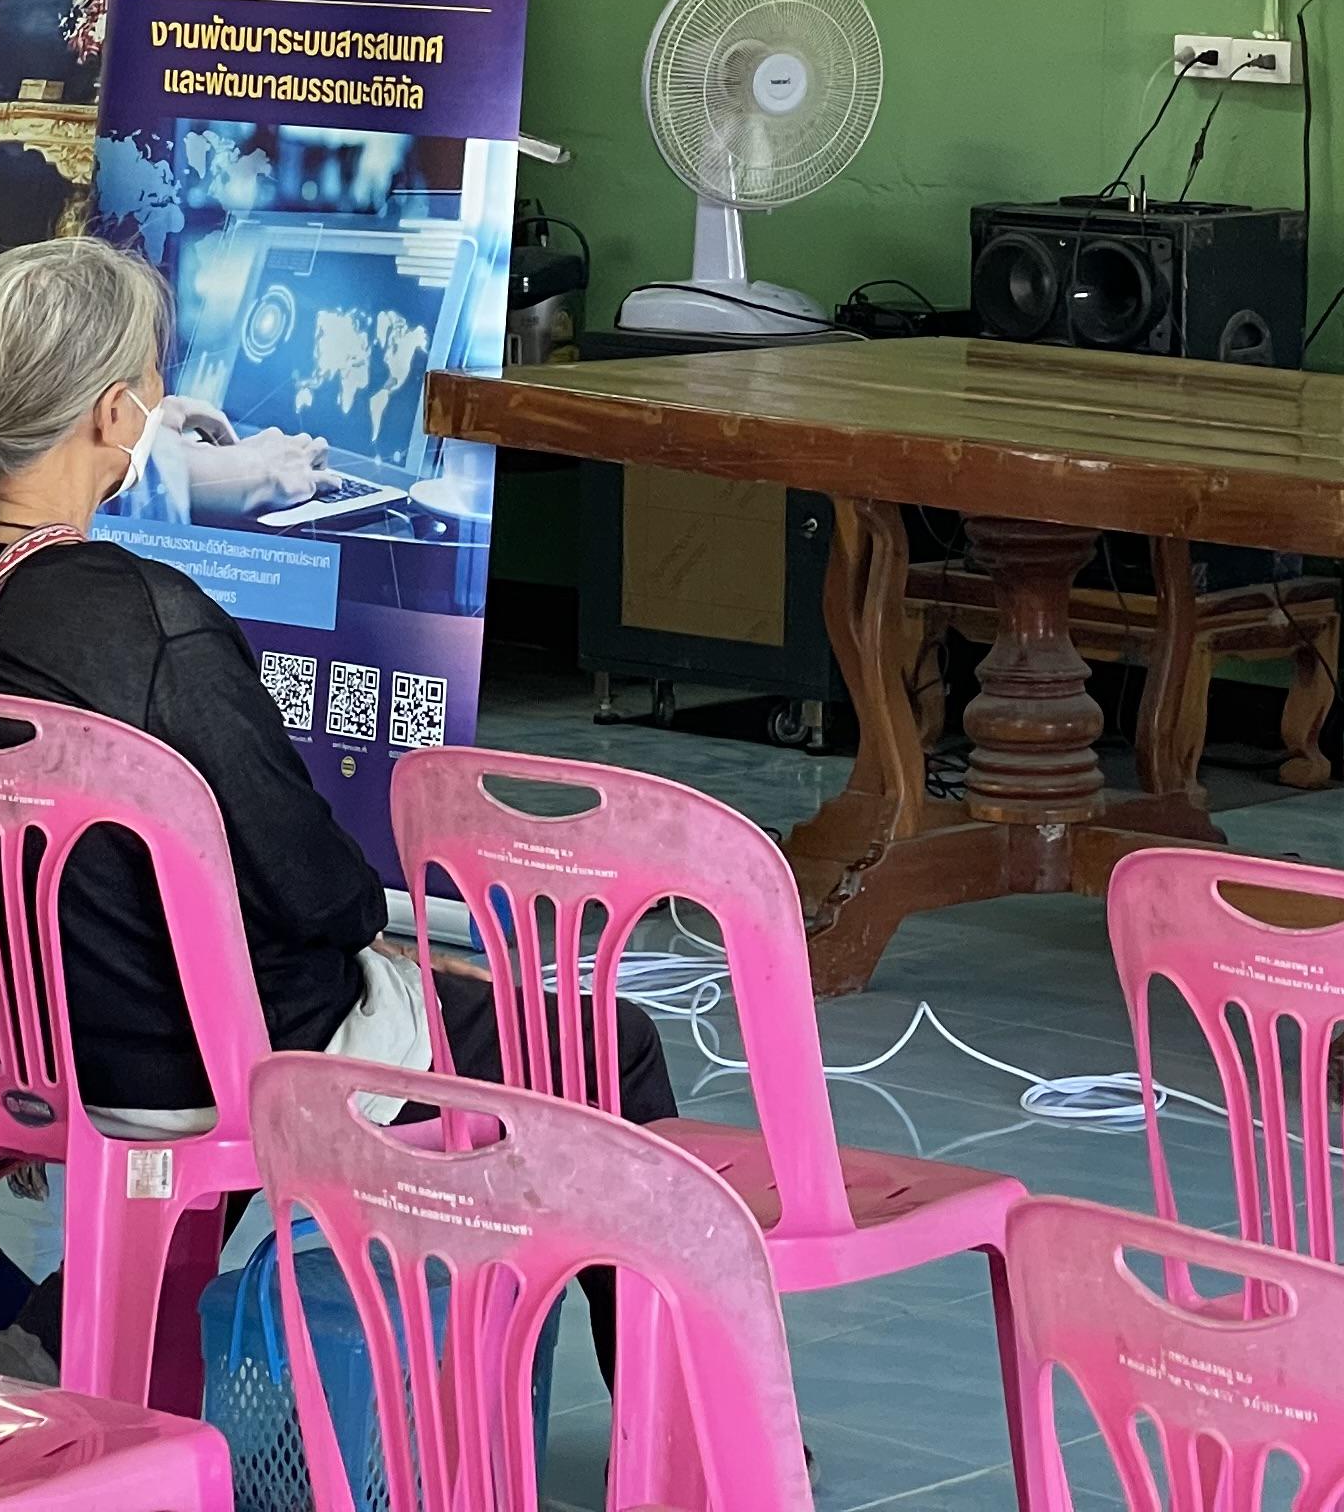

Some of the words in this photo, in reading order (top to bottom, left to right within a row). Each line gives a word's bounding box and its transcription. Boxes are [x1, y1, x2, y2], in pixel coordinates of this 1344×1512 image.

[150, 15, 444, 64] งานพัฒนาระบบสารสนเทศ
[163, 64, 424, 110] และพัฒนาสมรรถนะดิจิทัล
